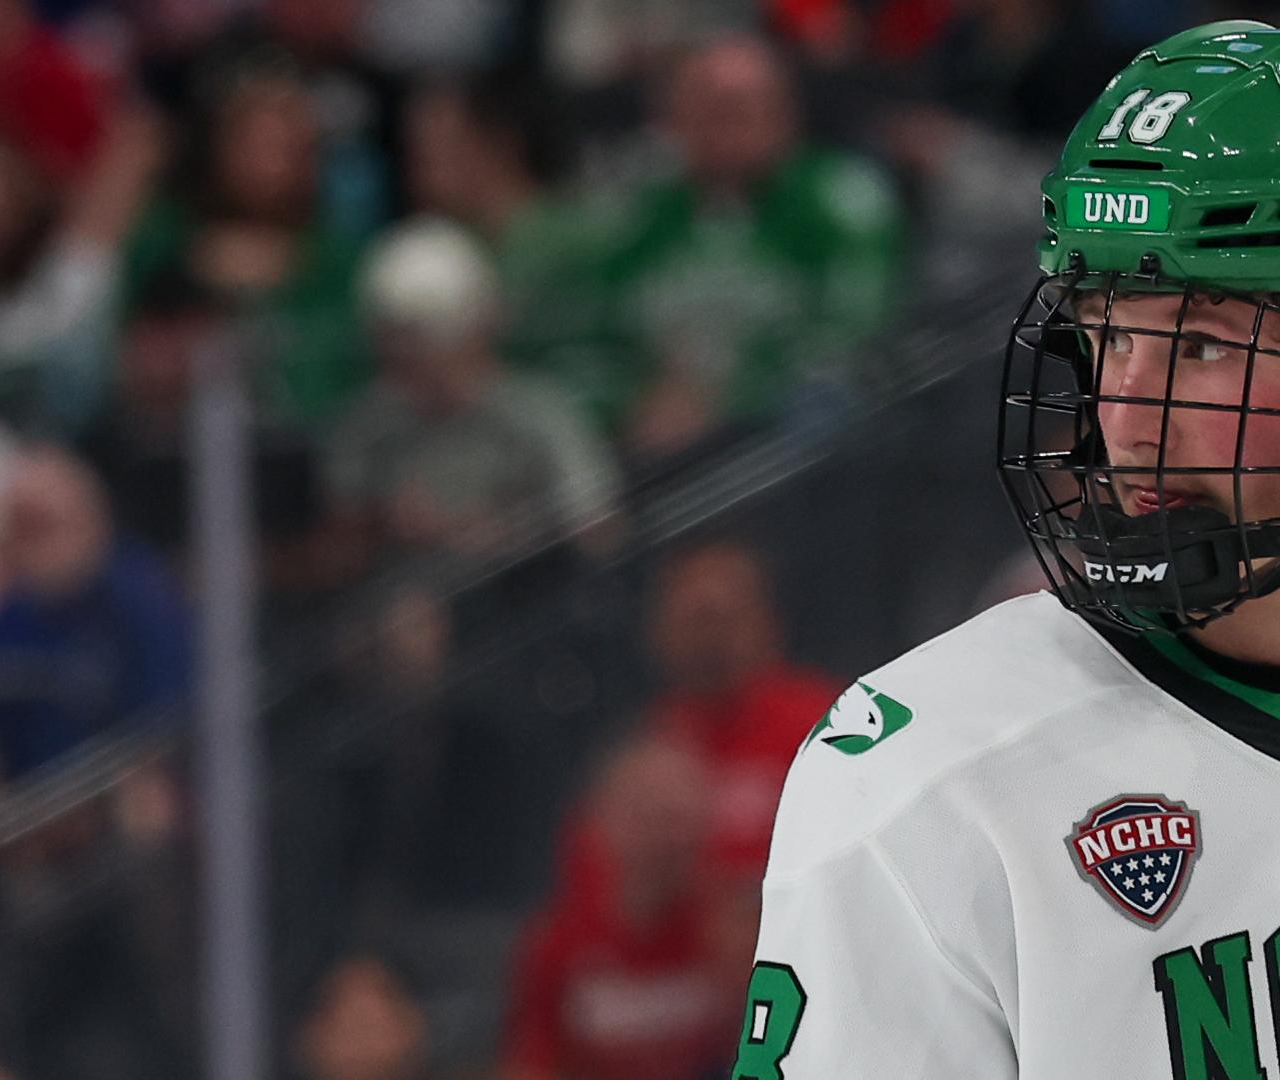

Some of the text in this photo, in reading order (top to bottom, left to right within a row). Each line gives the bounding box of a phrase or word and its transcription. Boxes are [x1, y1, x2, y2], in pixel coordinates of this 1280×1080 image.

[1096, 88, 1191, 146] 18
[1083, 191, 1150, 225] UND
[1083, 560, 1169, 583] CCM
[1077, 816, 1193, 866] NCHC
